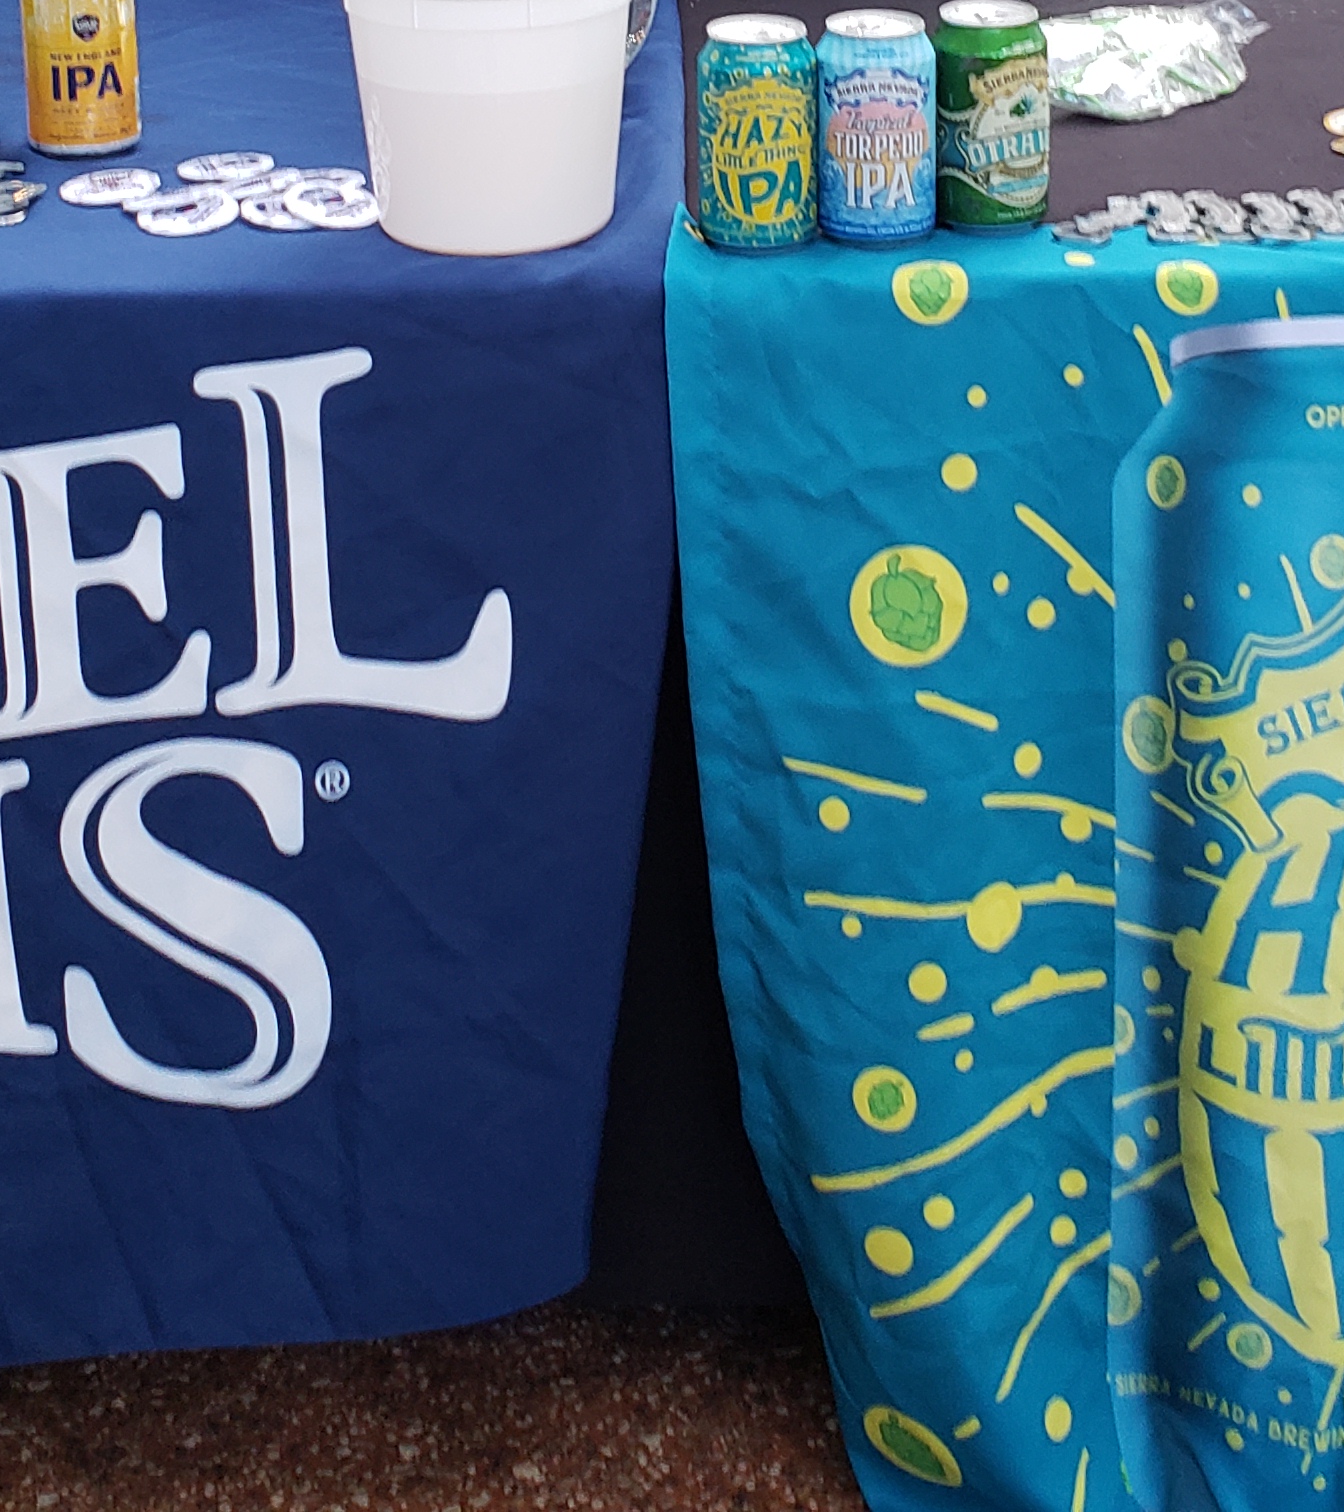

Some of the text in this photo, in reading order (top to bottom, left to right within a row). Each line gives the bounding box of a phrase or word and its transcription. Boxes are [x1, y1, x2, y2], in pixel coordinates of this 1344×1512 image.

[51, 61, 124, 102] IPA
[720, 114, 804, 149] HAZY
[834, 130, 925, 161] TORPEDO
[717, 160, 803, 216] IPA
[845, 161, 917, 209] IPA
